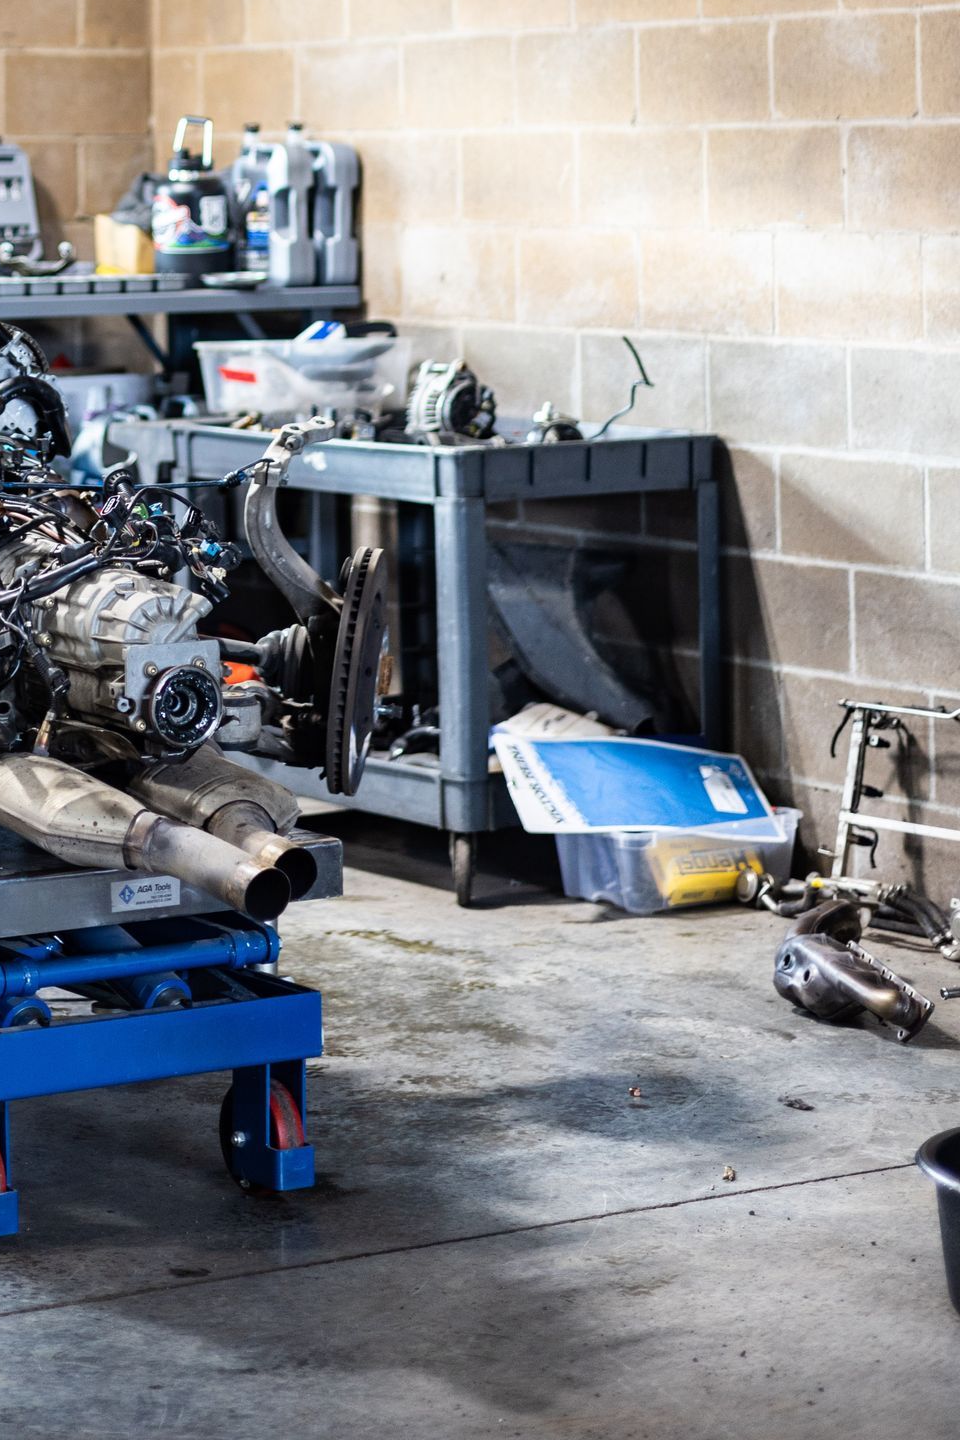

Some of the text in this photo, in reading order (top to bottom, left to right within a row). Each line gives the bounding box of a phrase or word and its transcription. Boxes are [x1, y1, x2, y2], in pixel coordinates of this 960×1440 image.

[528, 782, 567, 824] VICTOR
[136, 883, 172, 894] AGA Tools
